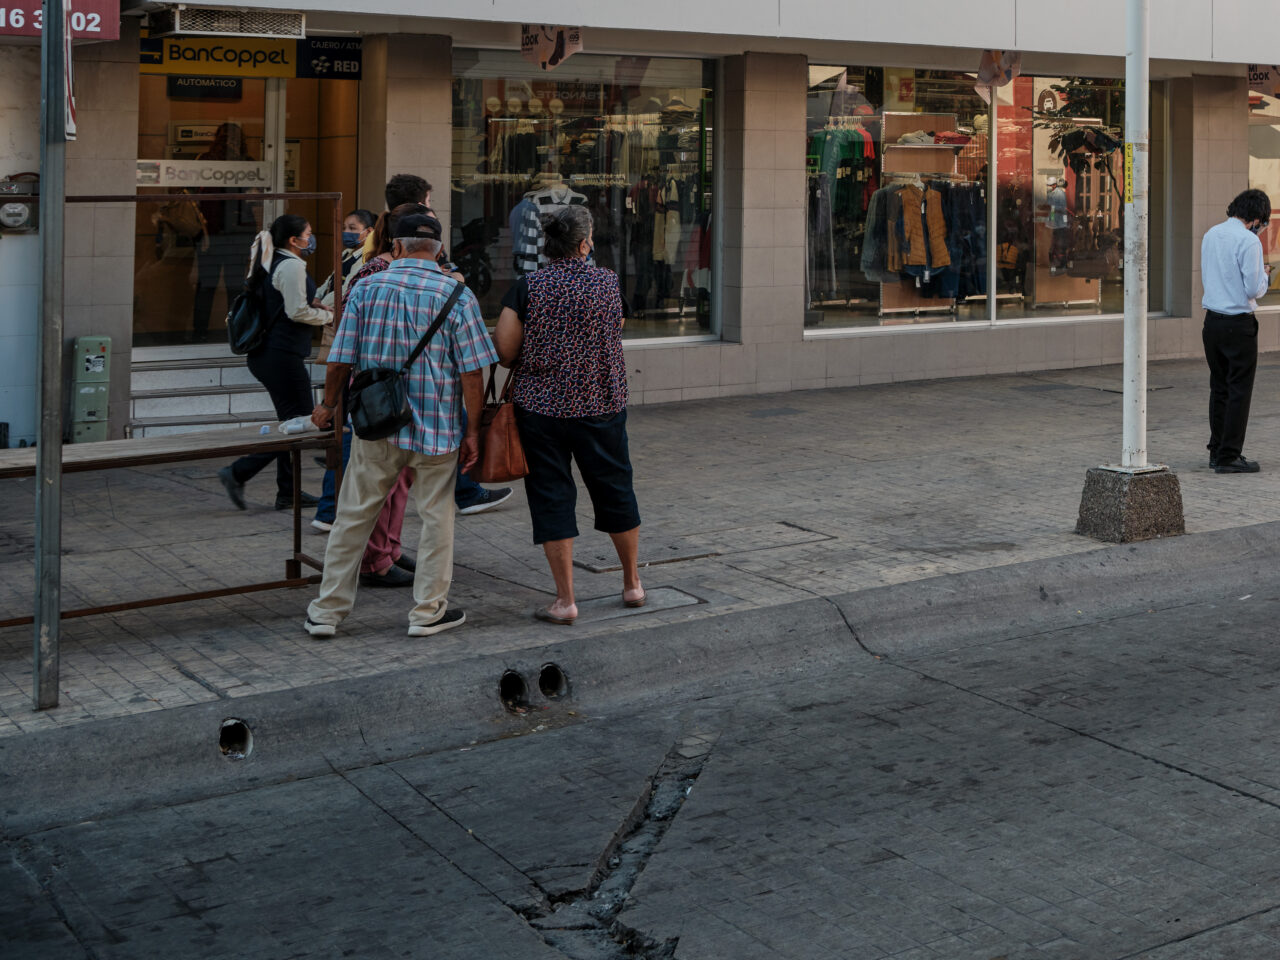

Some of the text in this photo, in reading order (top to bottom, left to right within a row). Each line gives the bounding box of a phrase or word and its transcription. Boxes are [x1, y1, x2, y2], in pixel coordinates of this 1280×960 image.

[521, 34, 539, 46] LOOK
[169, 44, 290, 68] BanCoppel
[333, 60, 359, 72] RED
[1249, 71, 1270, 81] LOOK
[165, 166, 266, 185] BanCoppel
